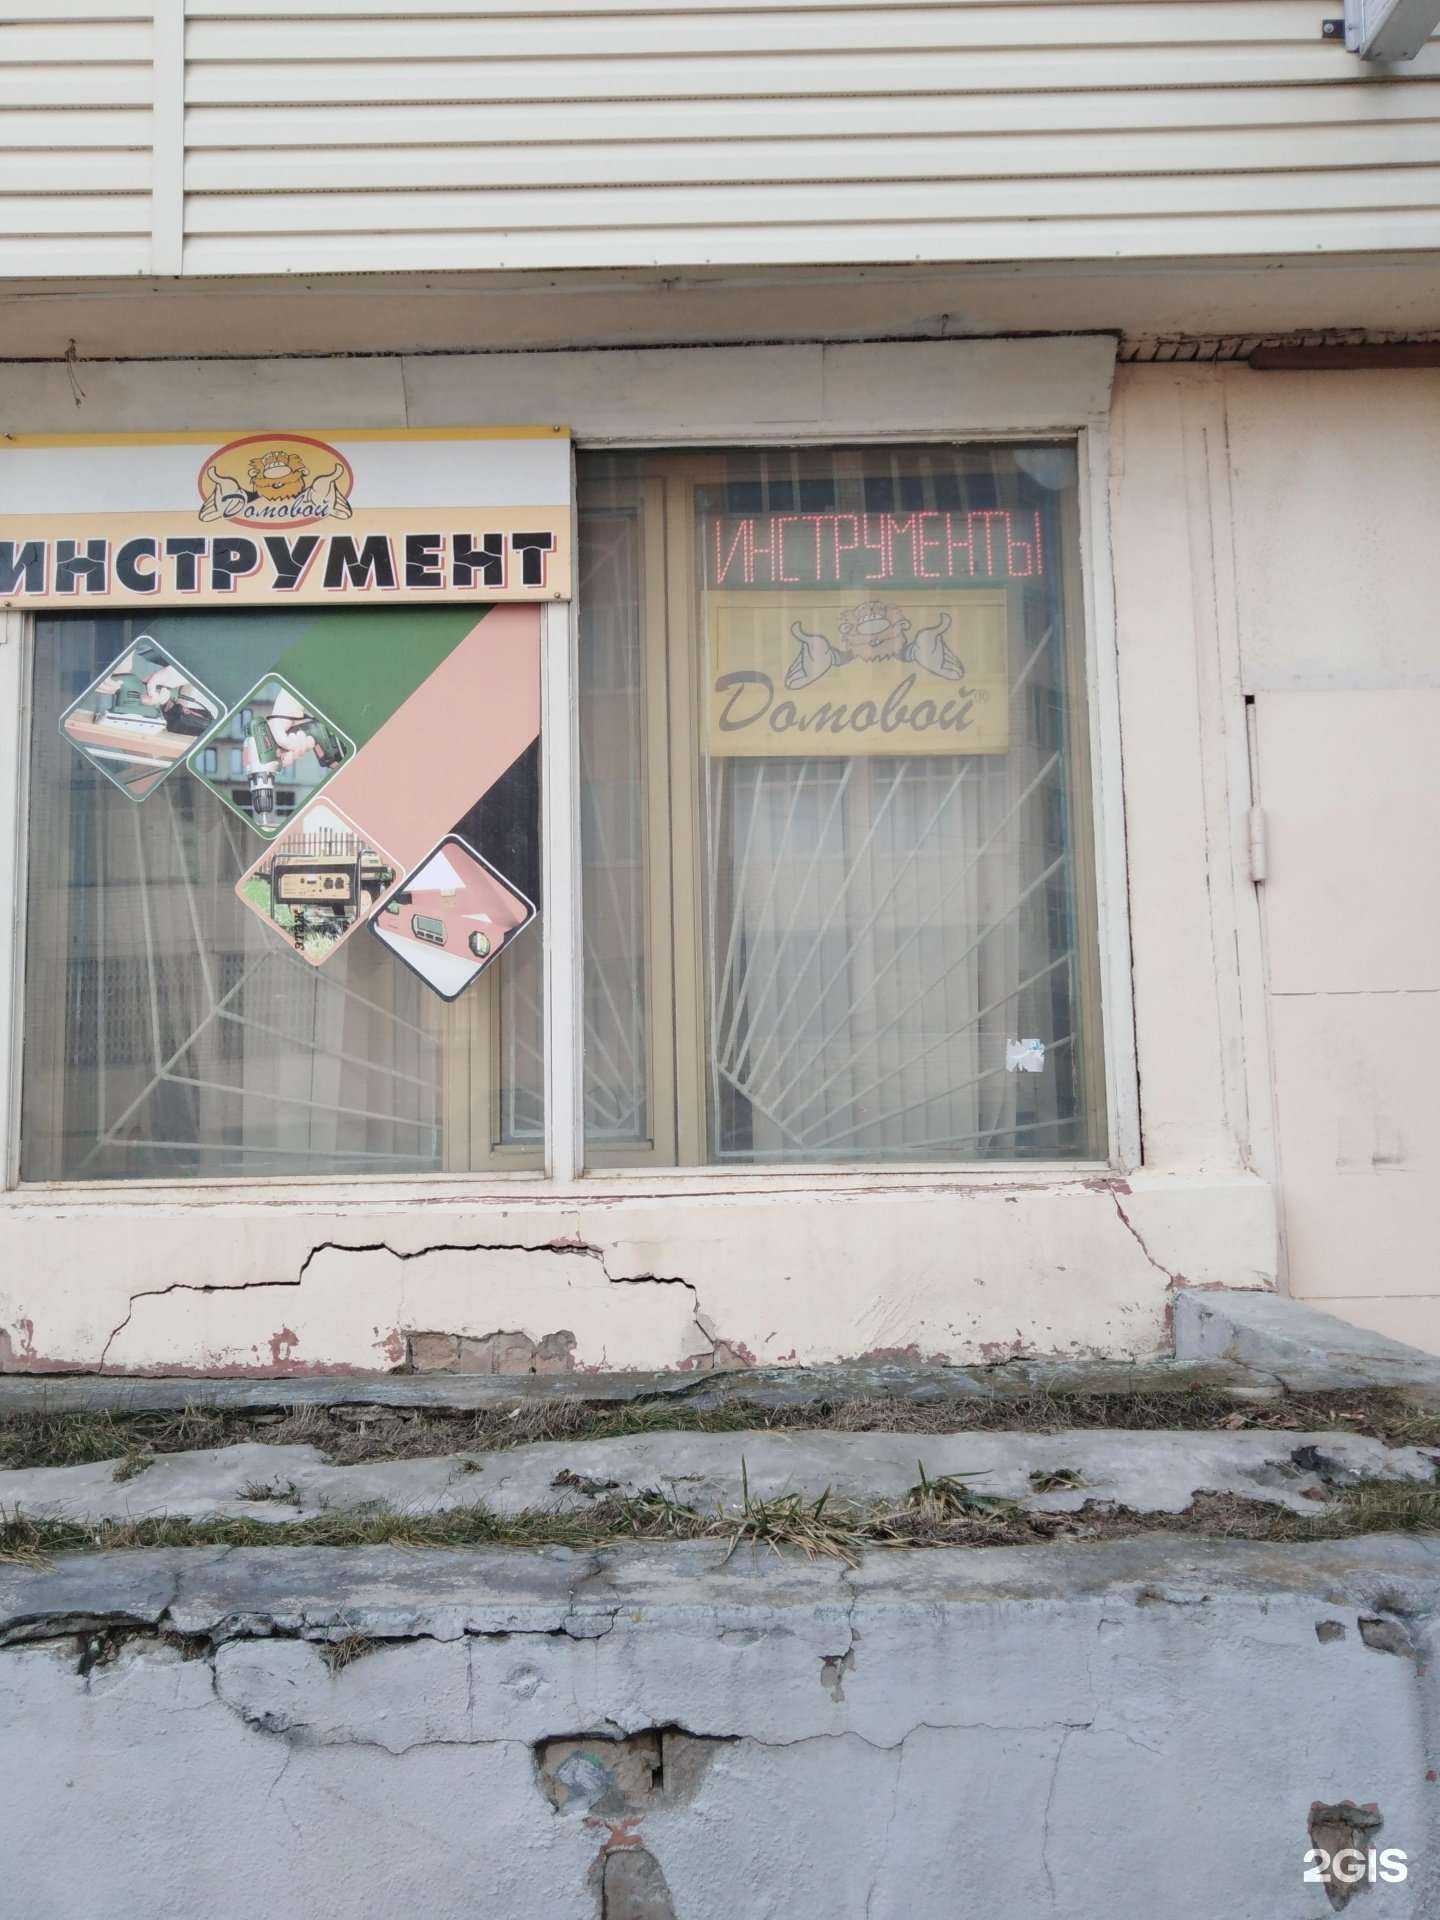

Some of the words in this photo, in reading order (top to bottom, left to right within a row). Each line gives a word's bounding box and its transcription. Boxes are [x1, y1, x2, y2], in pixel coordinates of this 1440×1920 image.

[221, 493, 330, 518] Домовой
[0, 532, 555, 594] ИНСТРУМЕНТ
[715, 510, 1044, 584] ИНСТРУМЕНТЫ
[714, 670, 978, 734] Домовой
